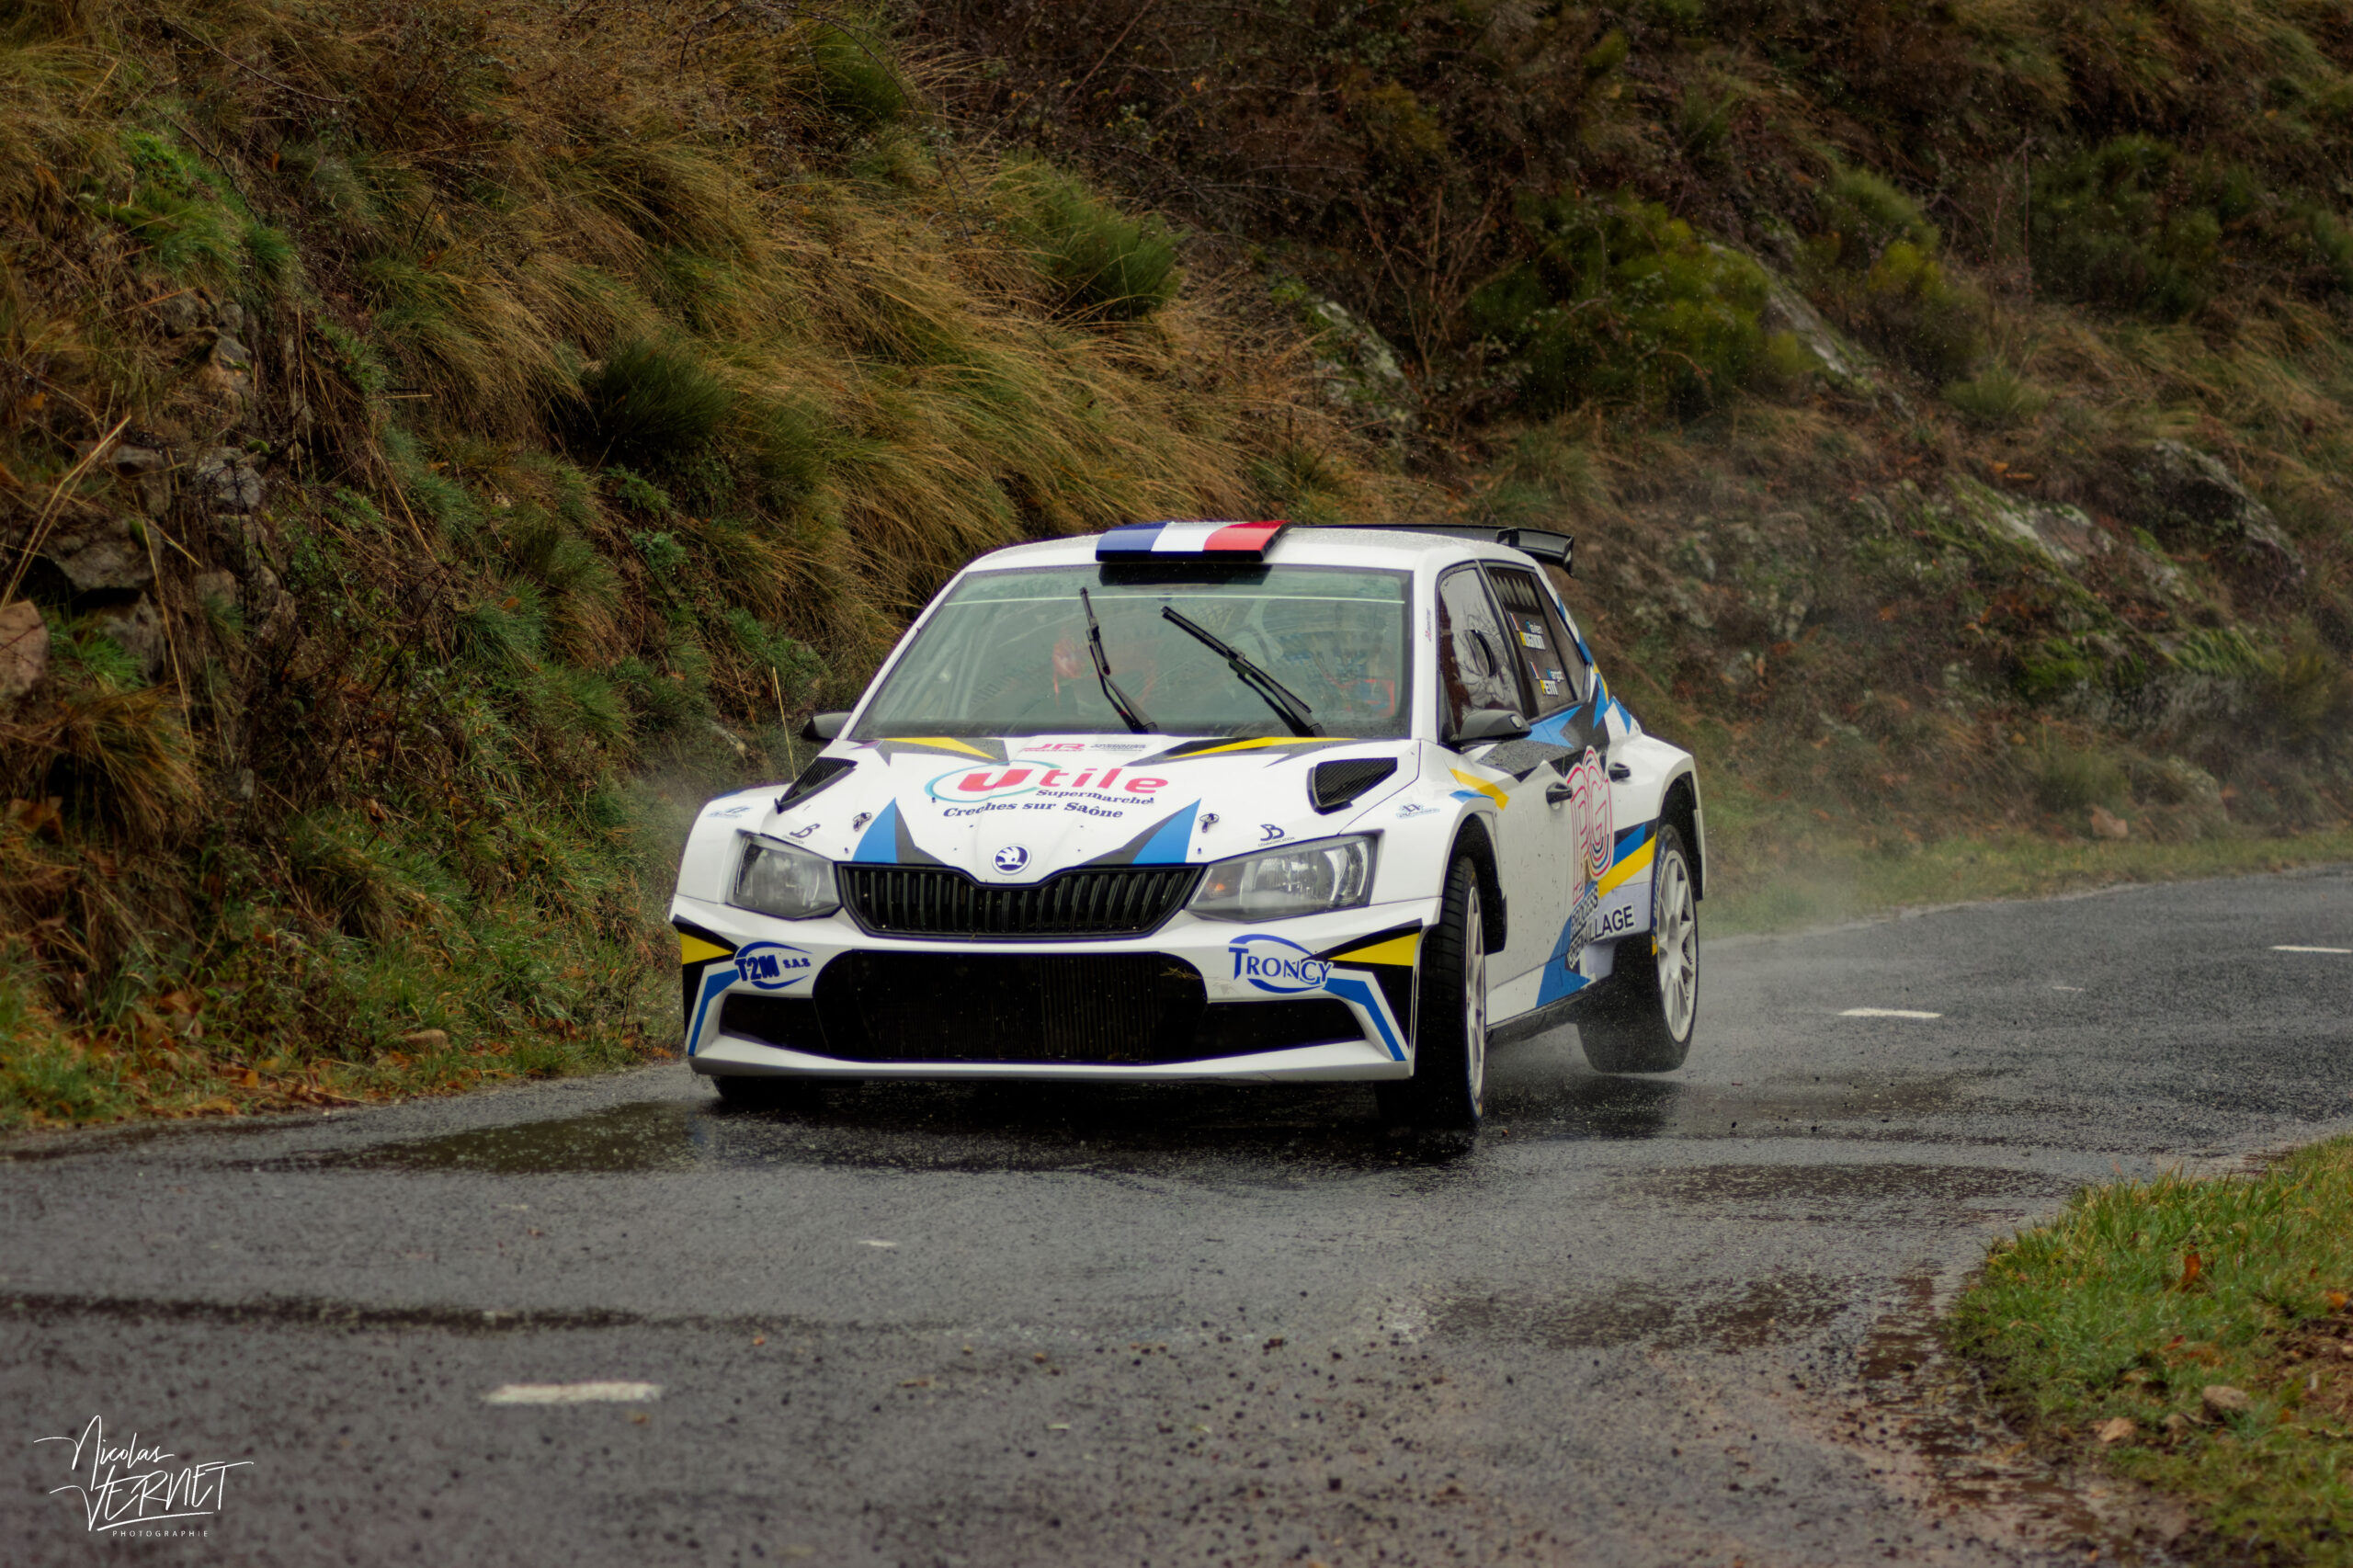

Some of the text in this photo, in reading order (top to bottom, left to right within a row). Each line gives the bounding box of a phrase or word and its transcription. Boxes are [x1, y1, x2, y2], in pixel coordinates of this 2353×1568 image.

[943, 801, 1017, 817] Creches
[1063, 801, 1123, 818] Saône
[734, 954, 780, 982] T2M
[1228, 947, 1332, 983] TRONCY
